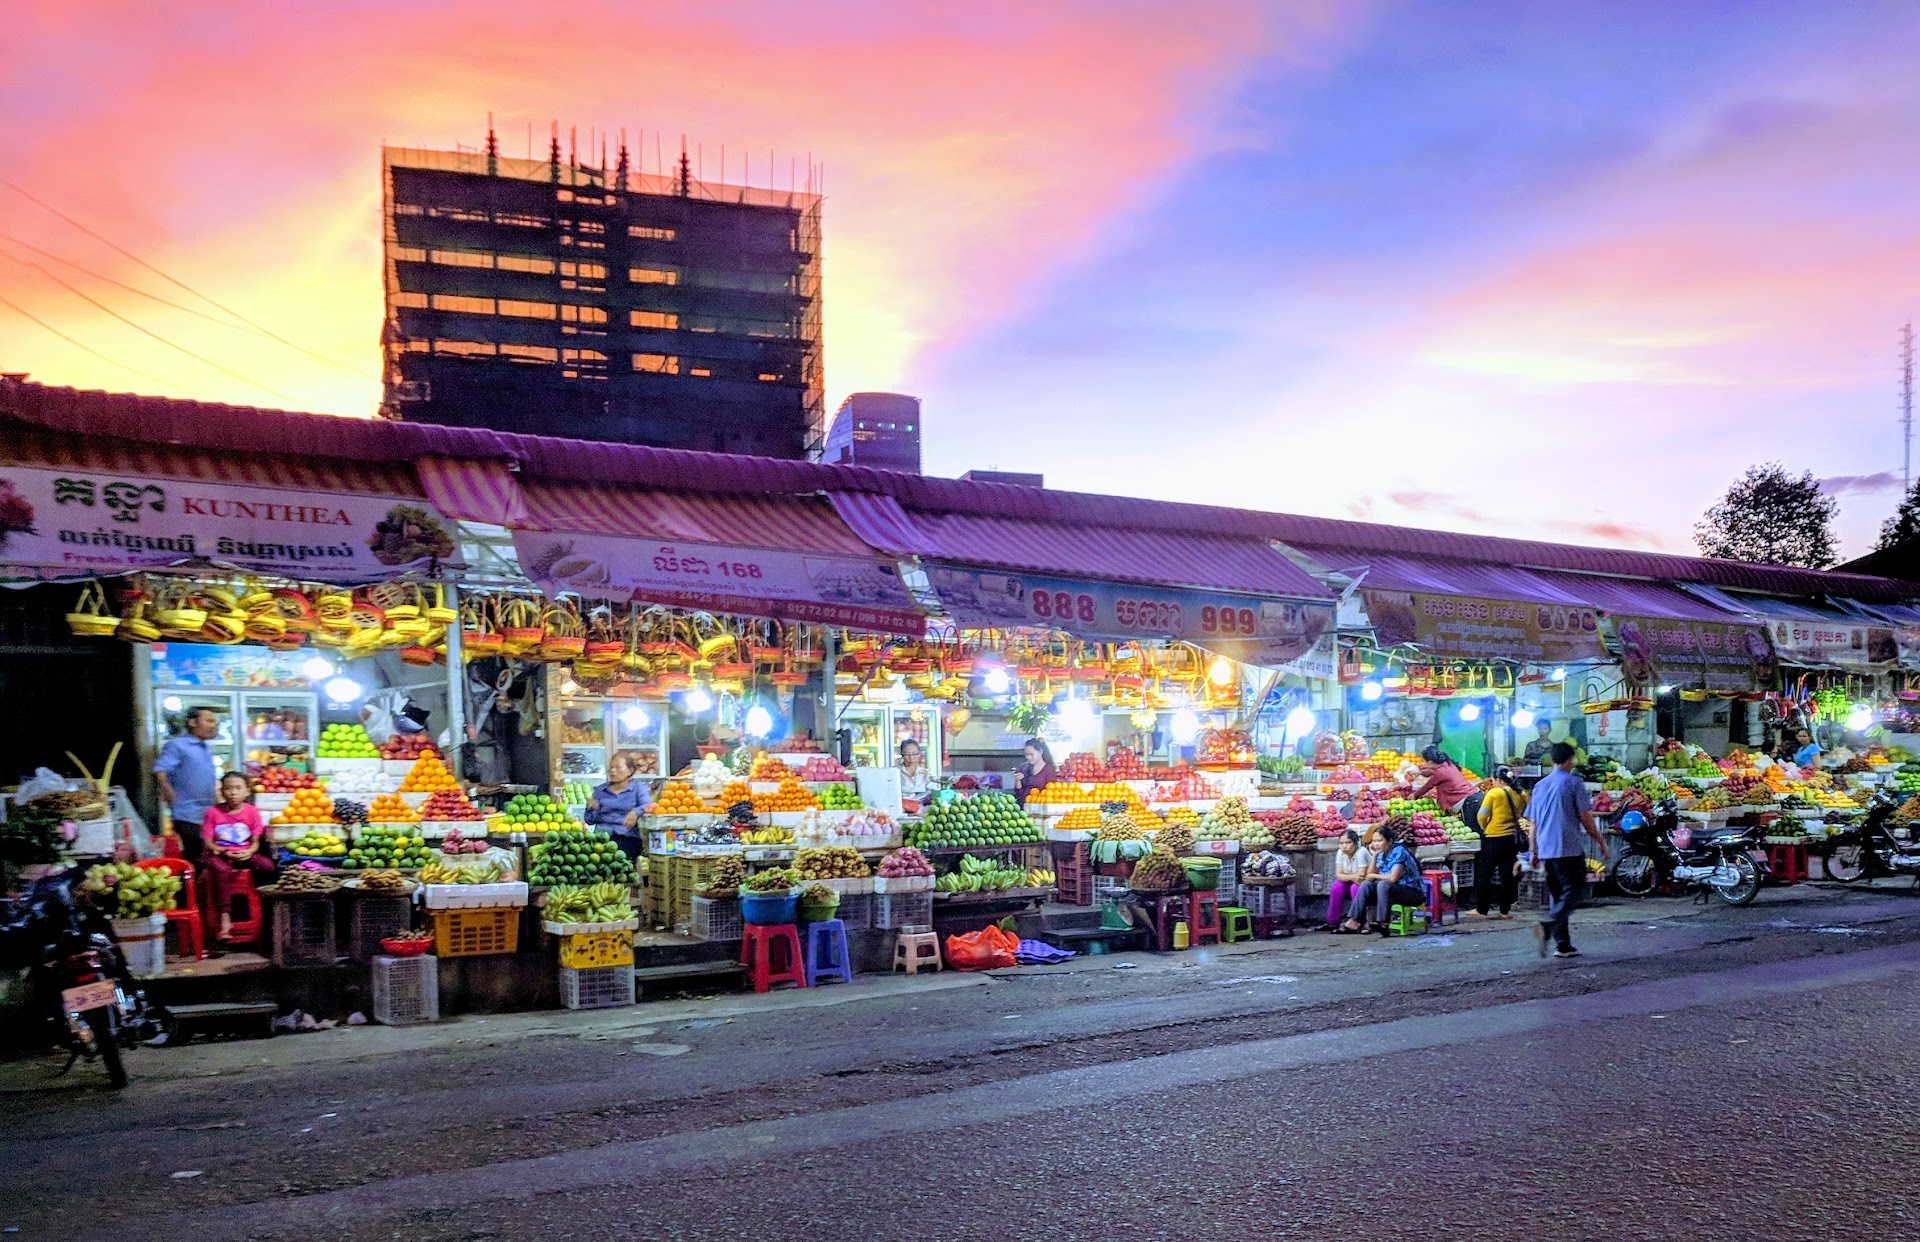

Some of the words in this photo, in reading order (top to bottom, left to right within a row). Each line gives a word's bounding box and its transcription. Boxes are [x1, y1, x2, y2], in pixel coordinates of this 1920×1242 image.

[181, 496, 353, 526] KUNTHEA
[717, 561, 762, 579] 168
[809, 605, 821, 616] 72
[1031, 589, 1095, 623] 888
[1201, 605, 1255, 634] 999
